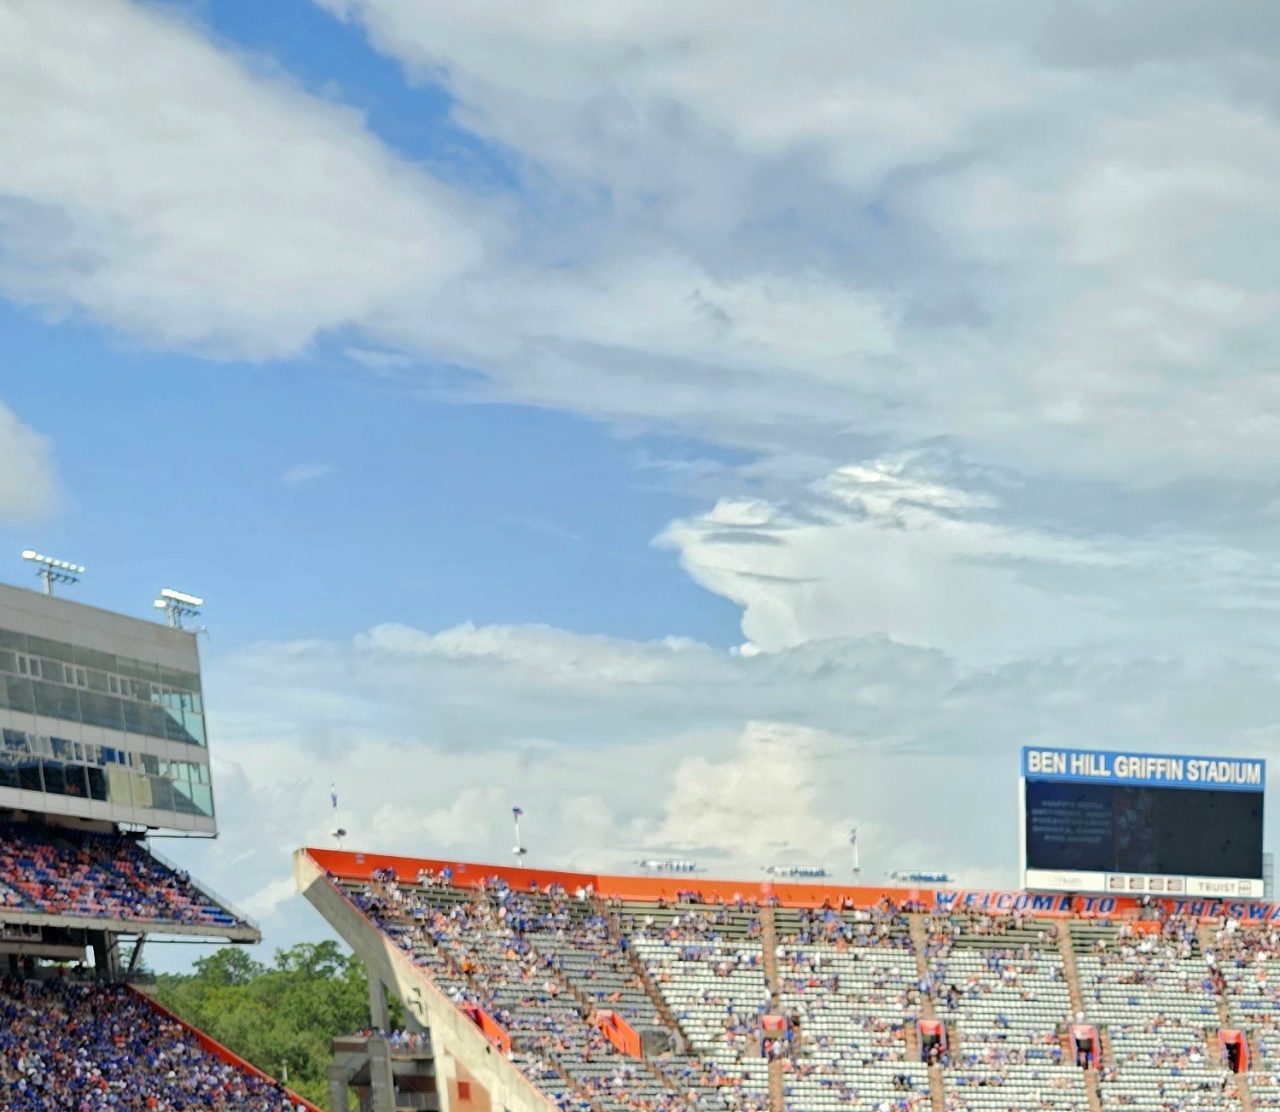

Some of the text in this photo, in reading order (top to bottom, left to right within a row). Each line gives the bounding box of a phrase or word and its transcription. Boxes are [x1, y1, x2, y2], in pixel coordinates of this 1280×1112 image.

[1027, 750, 1262, 785] BEN HILL GRIFFIN STADIUM
[1198, 882, 1235, 892] TRUIST
[934, 890, 1118, 913] WELCOME TO
[1174, 899, 1221, 917] THE
